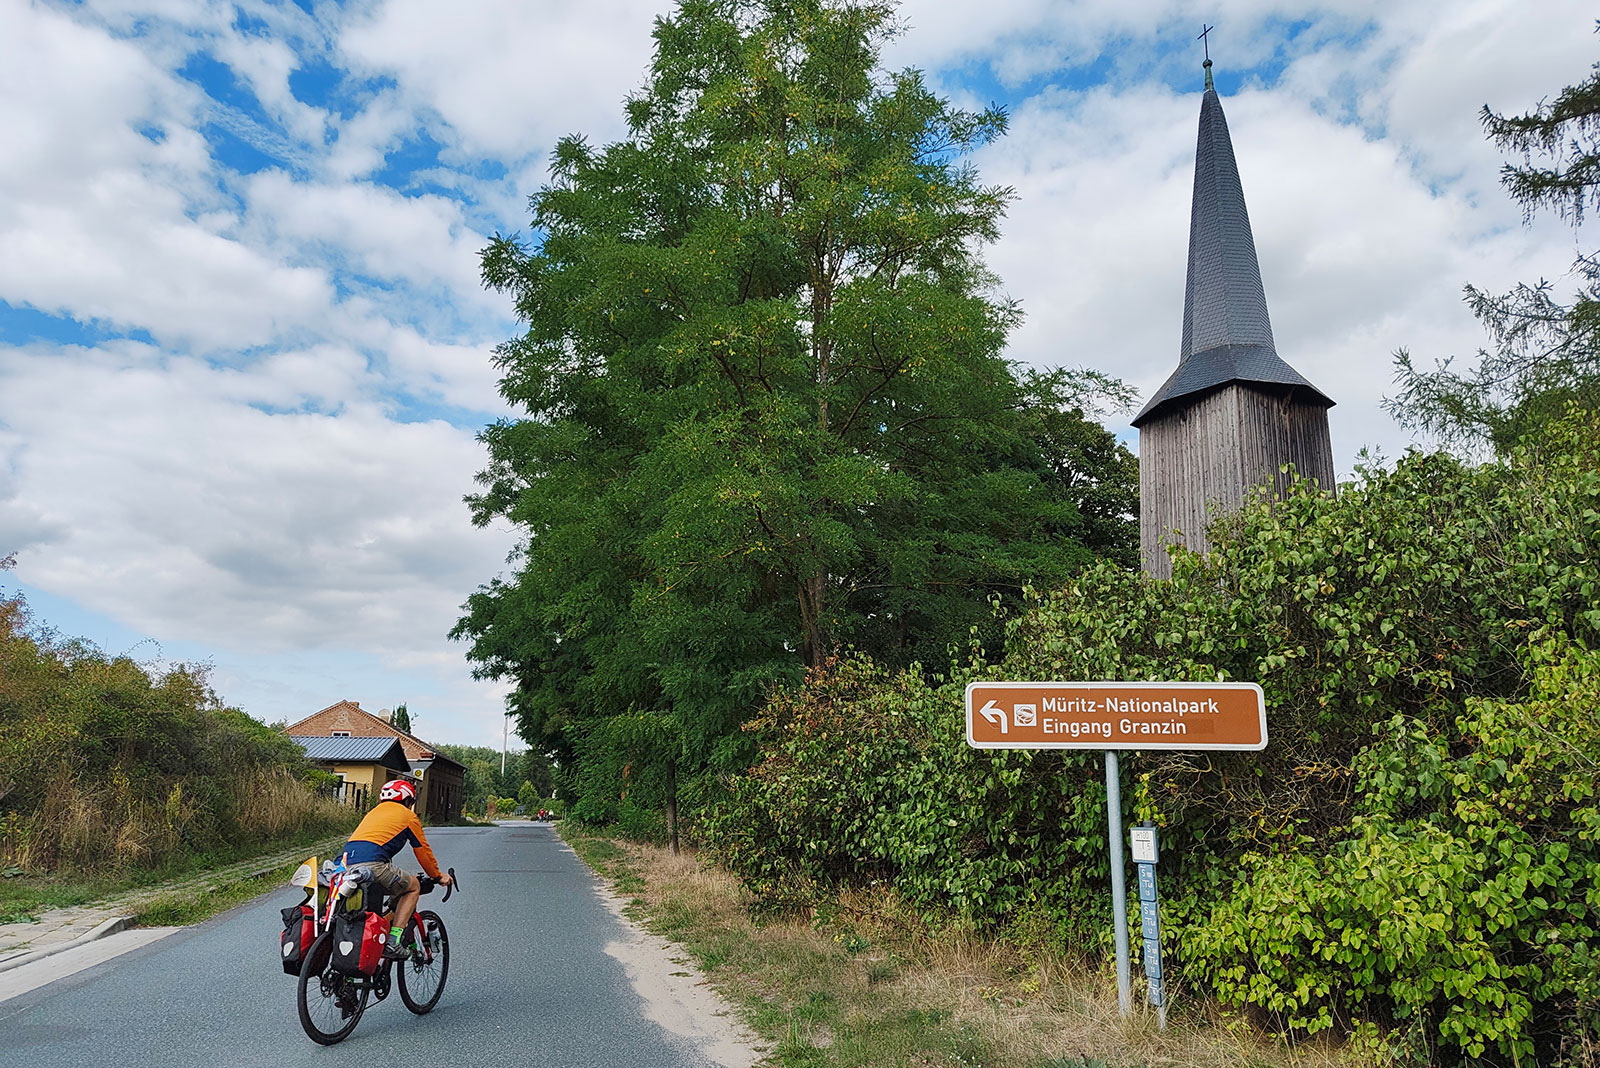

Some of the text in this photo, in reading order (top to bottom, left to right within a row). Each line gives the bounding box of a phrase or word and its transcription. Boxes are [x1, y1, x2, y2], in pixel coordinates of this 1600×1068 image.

[1042, 697, 1219, 717] Müritz-Nationalpark
[1043, 718, 1187, 738] Eingang Granzin
